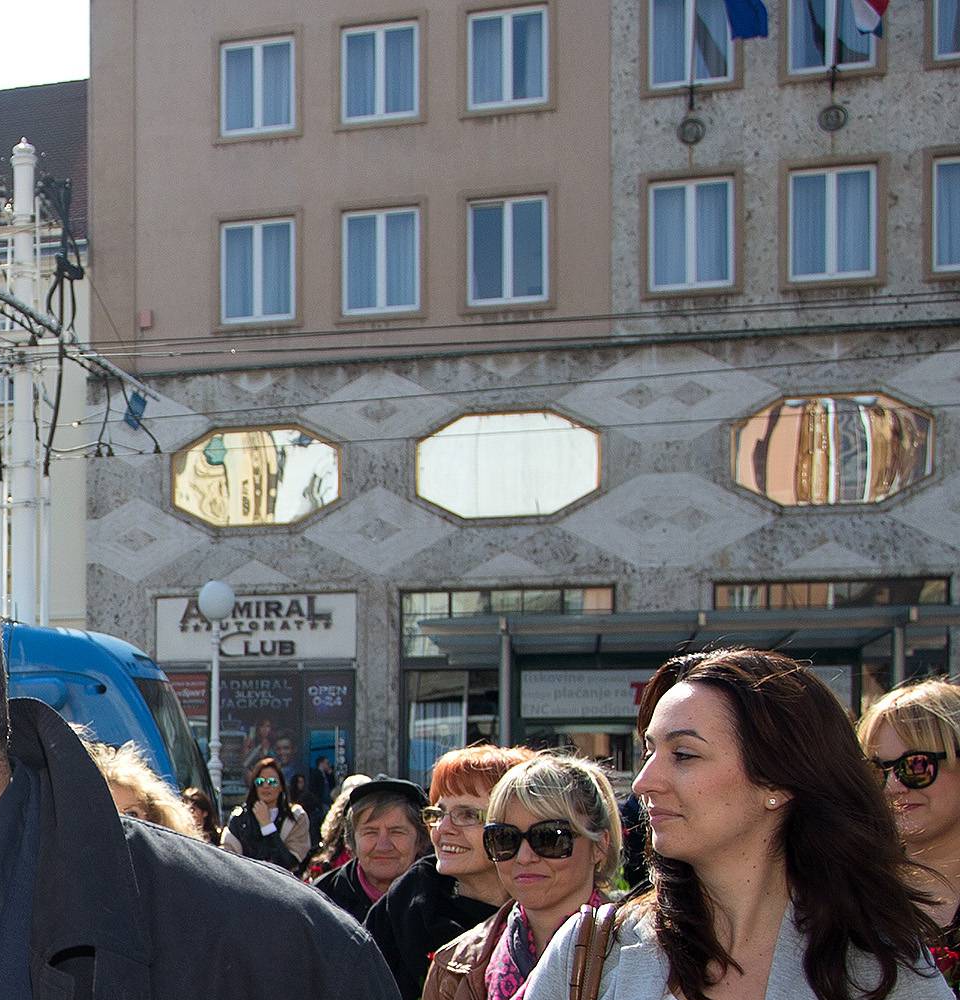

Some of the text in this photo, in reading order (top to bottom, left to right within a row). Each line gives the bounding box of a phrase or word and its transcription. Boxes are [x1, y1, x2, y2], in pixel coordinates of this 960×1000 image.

[180, 596, 331, 624] AMIRAL
[219, 631, 296, 657] CLUB
[308, 685, 348, 696] OPEN
